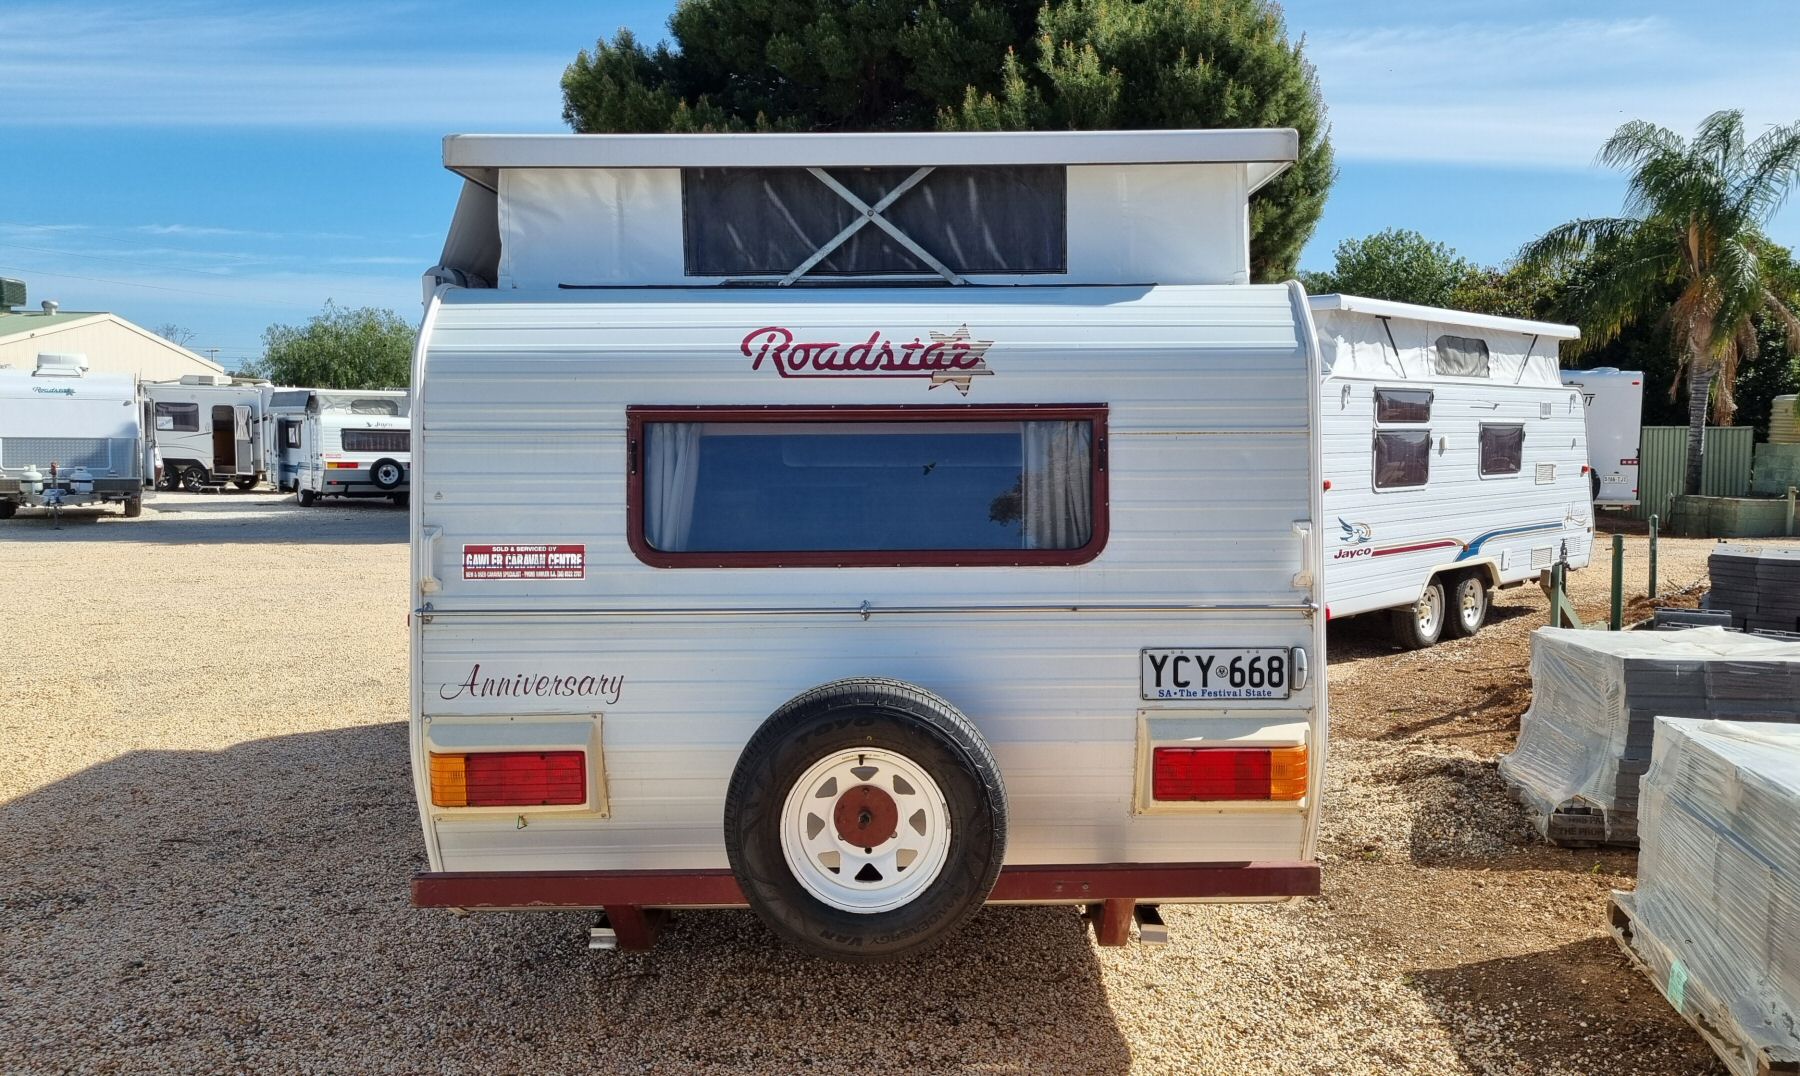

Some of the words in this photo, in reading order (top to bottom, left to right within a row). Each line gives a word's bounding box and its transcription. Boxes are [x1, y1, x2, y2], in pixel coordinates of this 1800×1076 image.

[741, 326, 980, 379] Roadstar
[466, 553, 503, 569] GAWLER
[505, 553, 546, 569] CARAVAN
[548, 553, 583, 569] CENTRE
[1333, 548, 1372, 559] Jayco
[1149, 655, 1215, 688] YCY
[1229, 655, 1284, 688] 668
[440, 664, 624, 704] Anniversary
[1199, 689, 1242, 697] Festival
[1245, 689, 1272, 697] State
